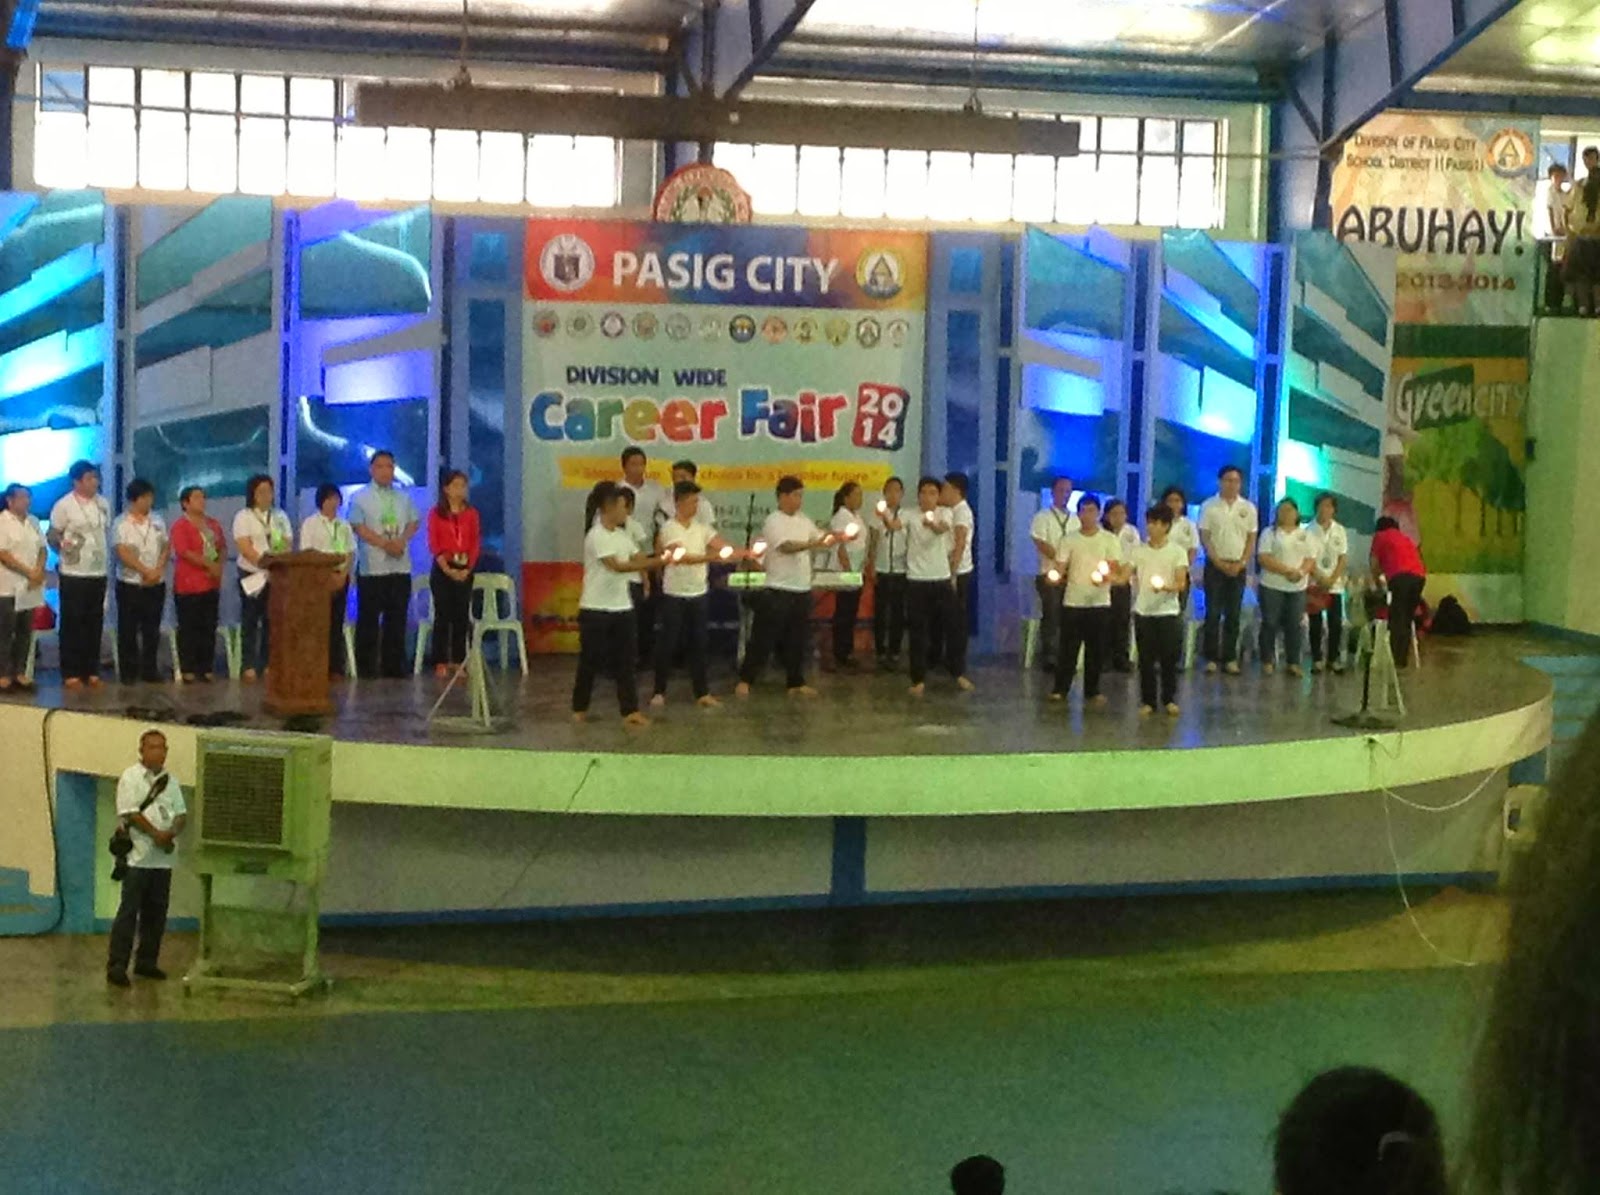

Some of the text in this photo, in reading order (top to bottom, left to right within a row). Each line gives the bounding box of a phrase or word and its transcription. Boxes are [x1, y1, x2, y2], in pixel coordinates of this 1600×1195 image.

[1420, 135, 1451, 150] PASIG
[1454, 136, 1476, 151] CITY
[612, 251, 839, 295] PASIG CITY
[566, 366, 728, 388] DIVISION WIDE
[529, 388, 848, 444] Career Fair
